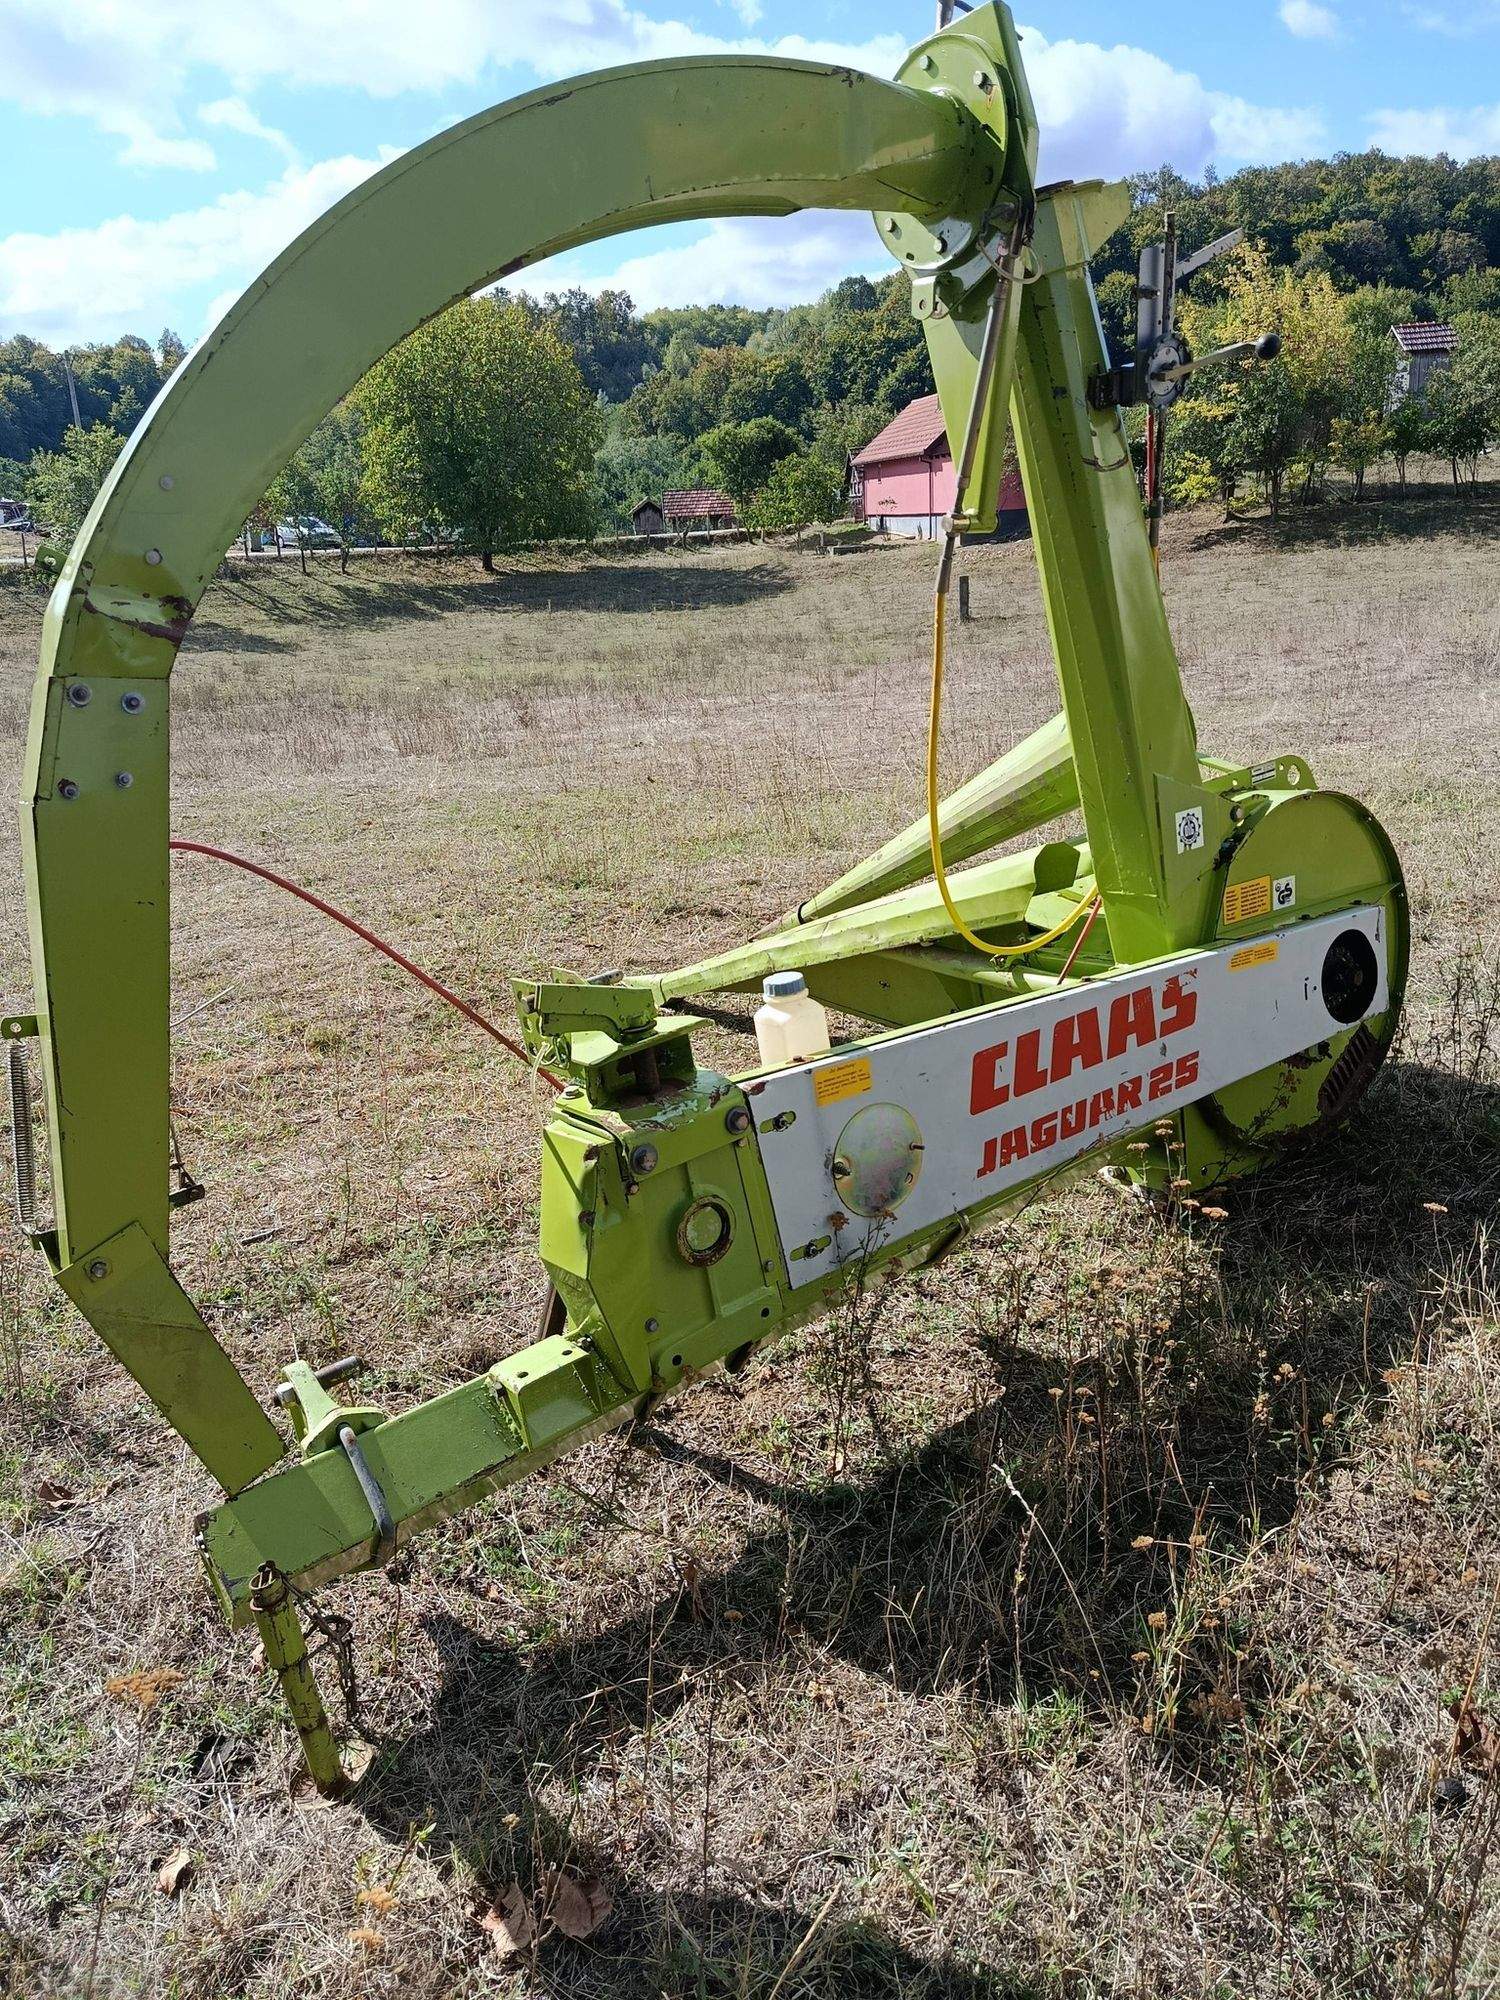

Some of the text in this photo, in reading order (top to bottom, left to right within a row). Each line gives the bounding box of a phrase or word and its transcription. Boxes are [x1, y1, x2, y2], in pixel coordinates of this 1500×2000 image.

[969, 968, 1198, 1115] CLAAS
[977, 1051, 1200, 1179] JAGUAR 25
